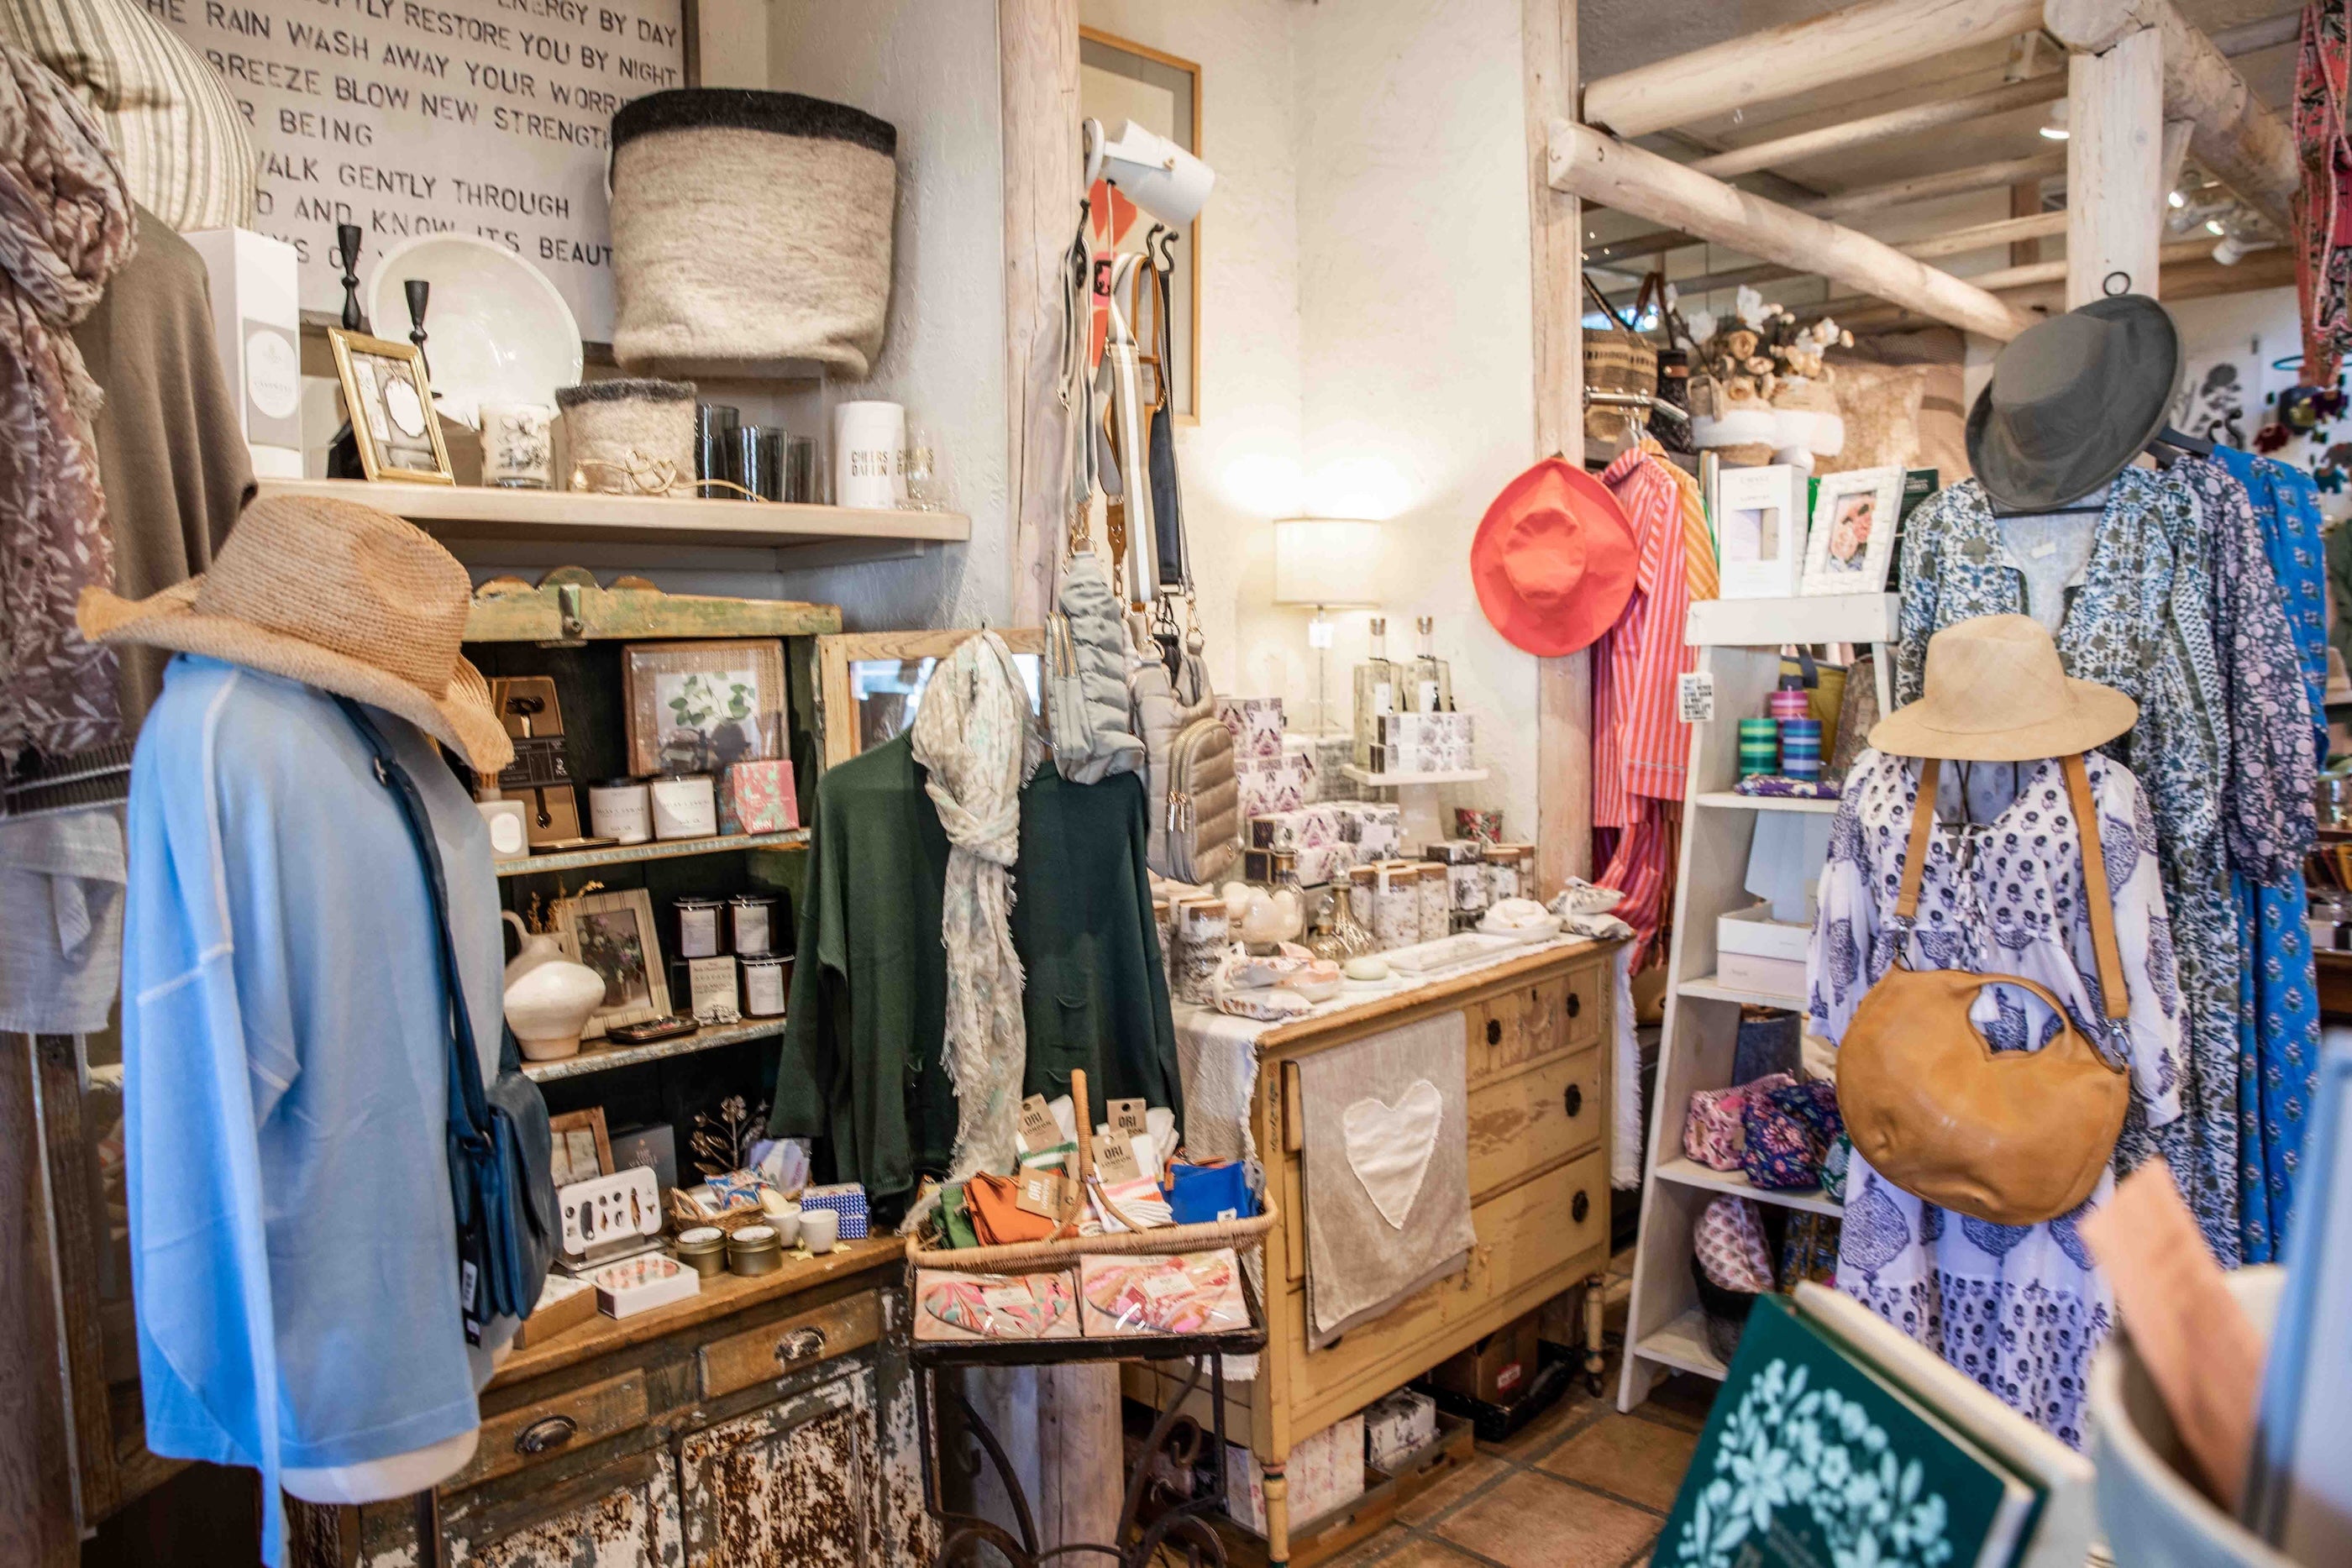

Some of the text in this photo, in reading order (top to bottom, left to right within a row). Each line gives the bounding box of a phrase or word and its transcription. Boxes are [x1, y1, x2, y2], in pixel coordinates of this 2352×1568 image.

[404, 3, 511, 50] RESTORE
[519, 30, 570, 65] YOU
[580, 45, 609, 71] BY
[618, 55, 677, 87] NIGHT
[599, 8, 627, 35] BY
[637, 18, 677, 49] DAY
[206, 1, 270, 39] RAIN
[286, 19, 370, 61] WASH
[382, 44, 450, 80] AWAY
[465, 59, 537, 98] YOUR
[205, 48, 322, 96] BREEZE
[335, 76, 409, 110] BLOW
[420, 92, 479, 126] NEW
[279, 108, 373, 147] BEING
[259, 149, 570, 220] ALK GENTLY THROUGH
[295, 195, 353, 226] AND
[1023, 1120, 1052, 1136] LONDON
[1024, 1112, 1043, 1127] ORI
[1118, 1115, 1137, 1129] ORI
[1101, 1156, 1133, 1168] LONDON
[1104, 1146, 1124, 1160] ORI
